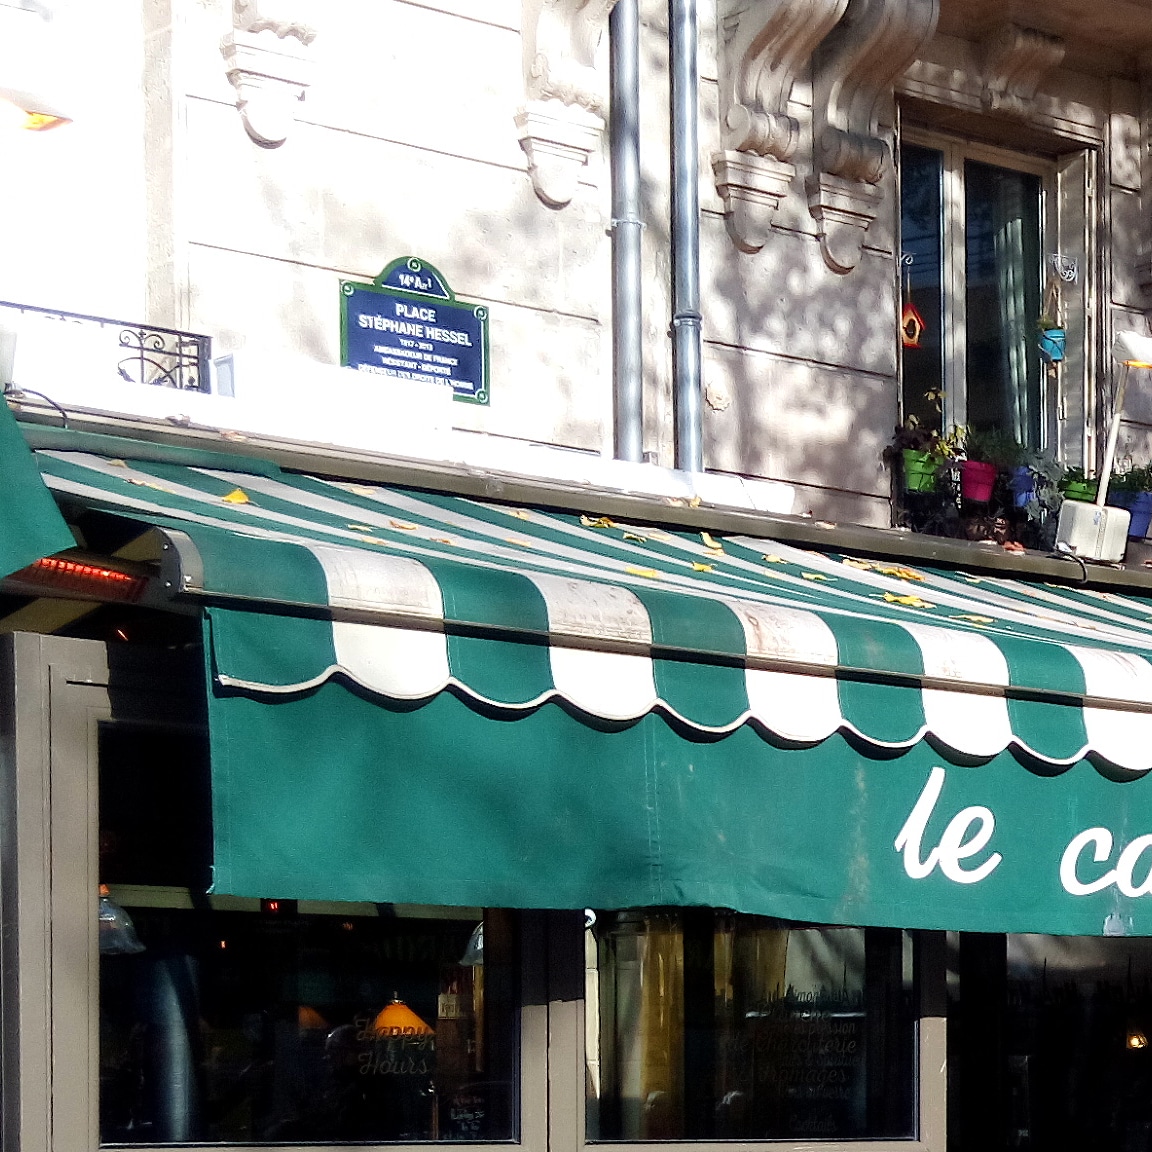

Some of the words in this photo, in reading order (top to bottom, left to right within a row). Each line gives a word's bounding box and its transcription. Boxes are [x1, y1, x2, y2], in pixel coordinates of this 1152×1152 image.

[395, 303, 436, 322] PLACE
[359, 314, 424, 338] STÉPHANE
[425, 324, 472, 347] HESSEL
[894, 766, 1003, 884] le
[357, 1050, 431, 1076] Hours
